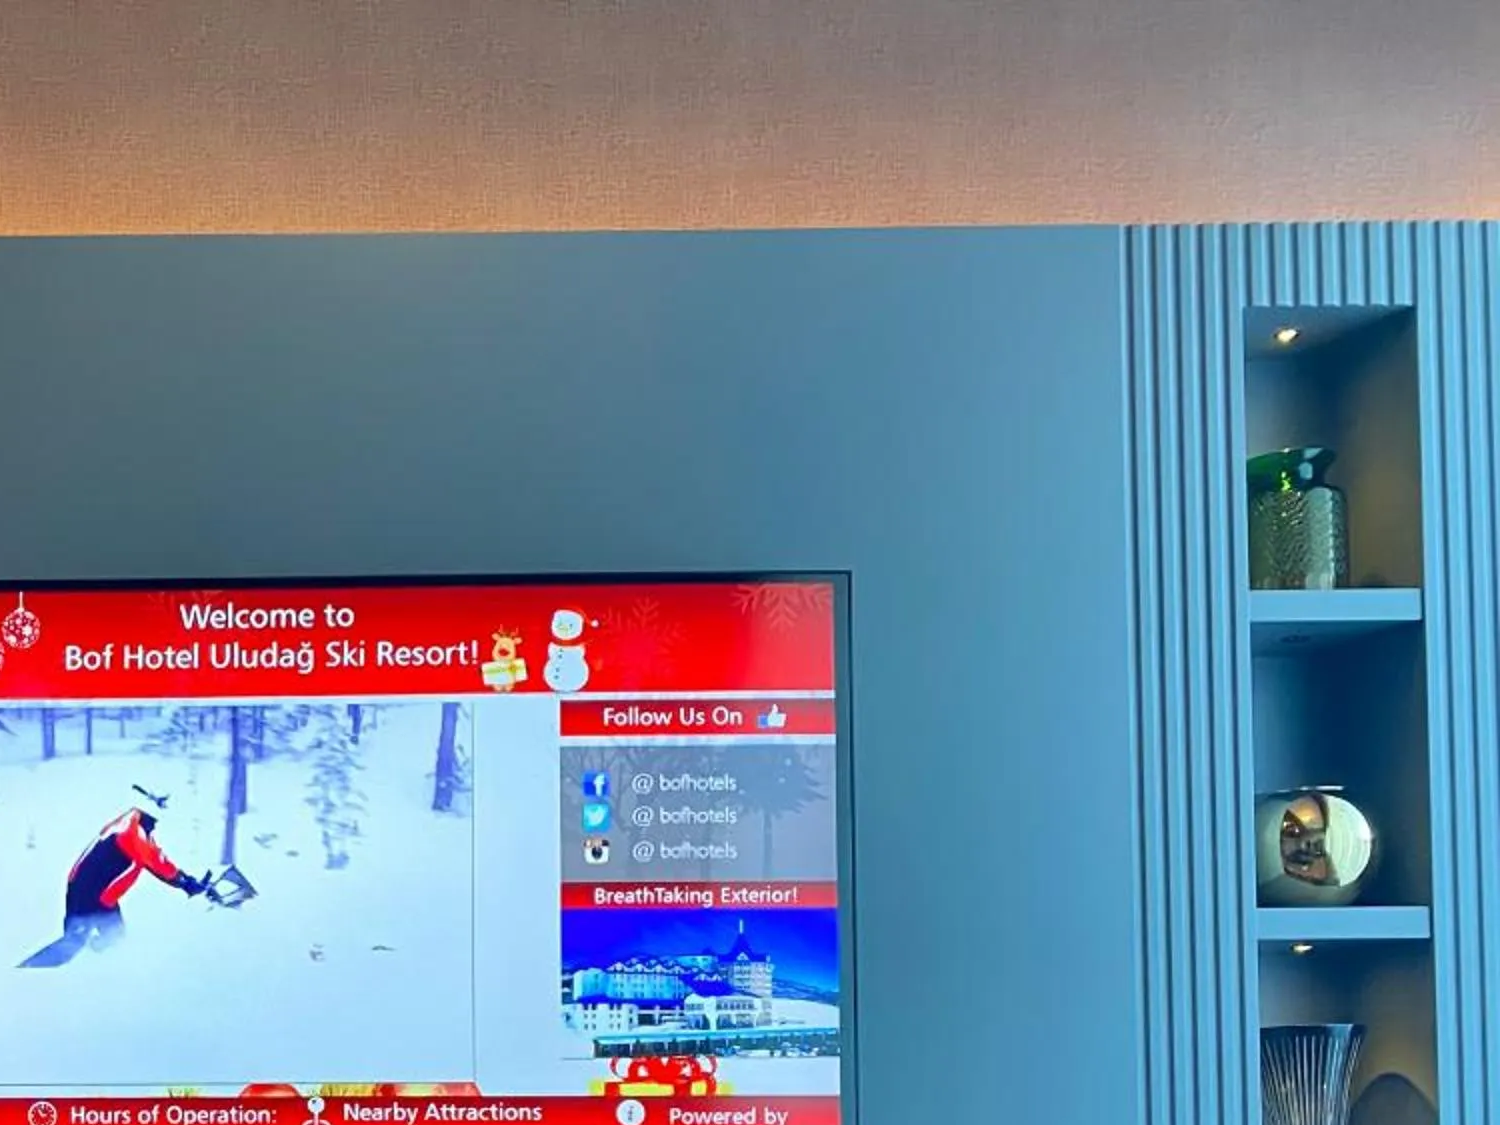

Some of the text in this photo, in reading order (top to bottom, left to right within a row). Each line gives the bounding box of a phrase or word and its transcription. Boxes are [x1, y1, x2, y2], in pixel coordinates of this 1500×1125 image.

[180, 602, 355, 629] Welcome to
[64, 640, 479, 674] Bof Hotel Uludağ Ski Resort!
[603, 706, 743, 726] Follow Us On
[631, 773, 737, 794] @ bofhotels
[631, 806, 737, 827] @ bofhotels
[632, 840, 738, 862] @ bofhotels
[594, 887, 798, 909] BreathTaking Exterior!
[70, 1105, 131, 1125] Hours
[137, 1105, 160, 1124] of
[343, 1103, 543, 1125] Nearby Attractions
[669, 1108, 756, 1125] Powered
